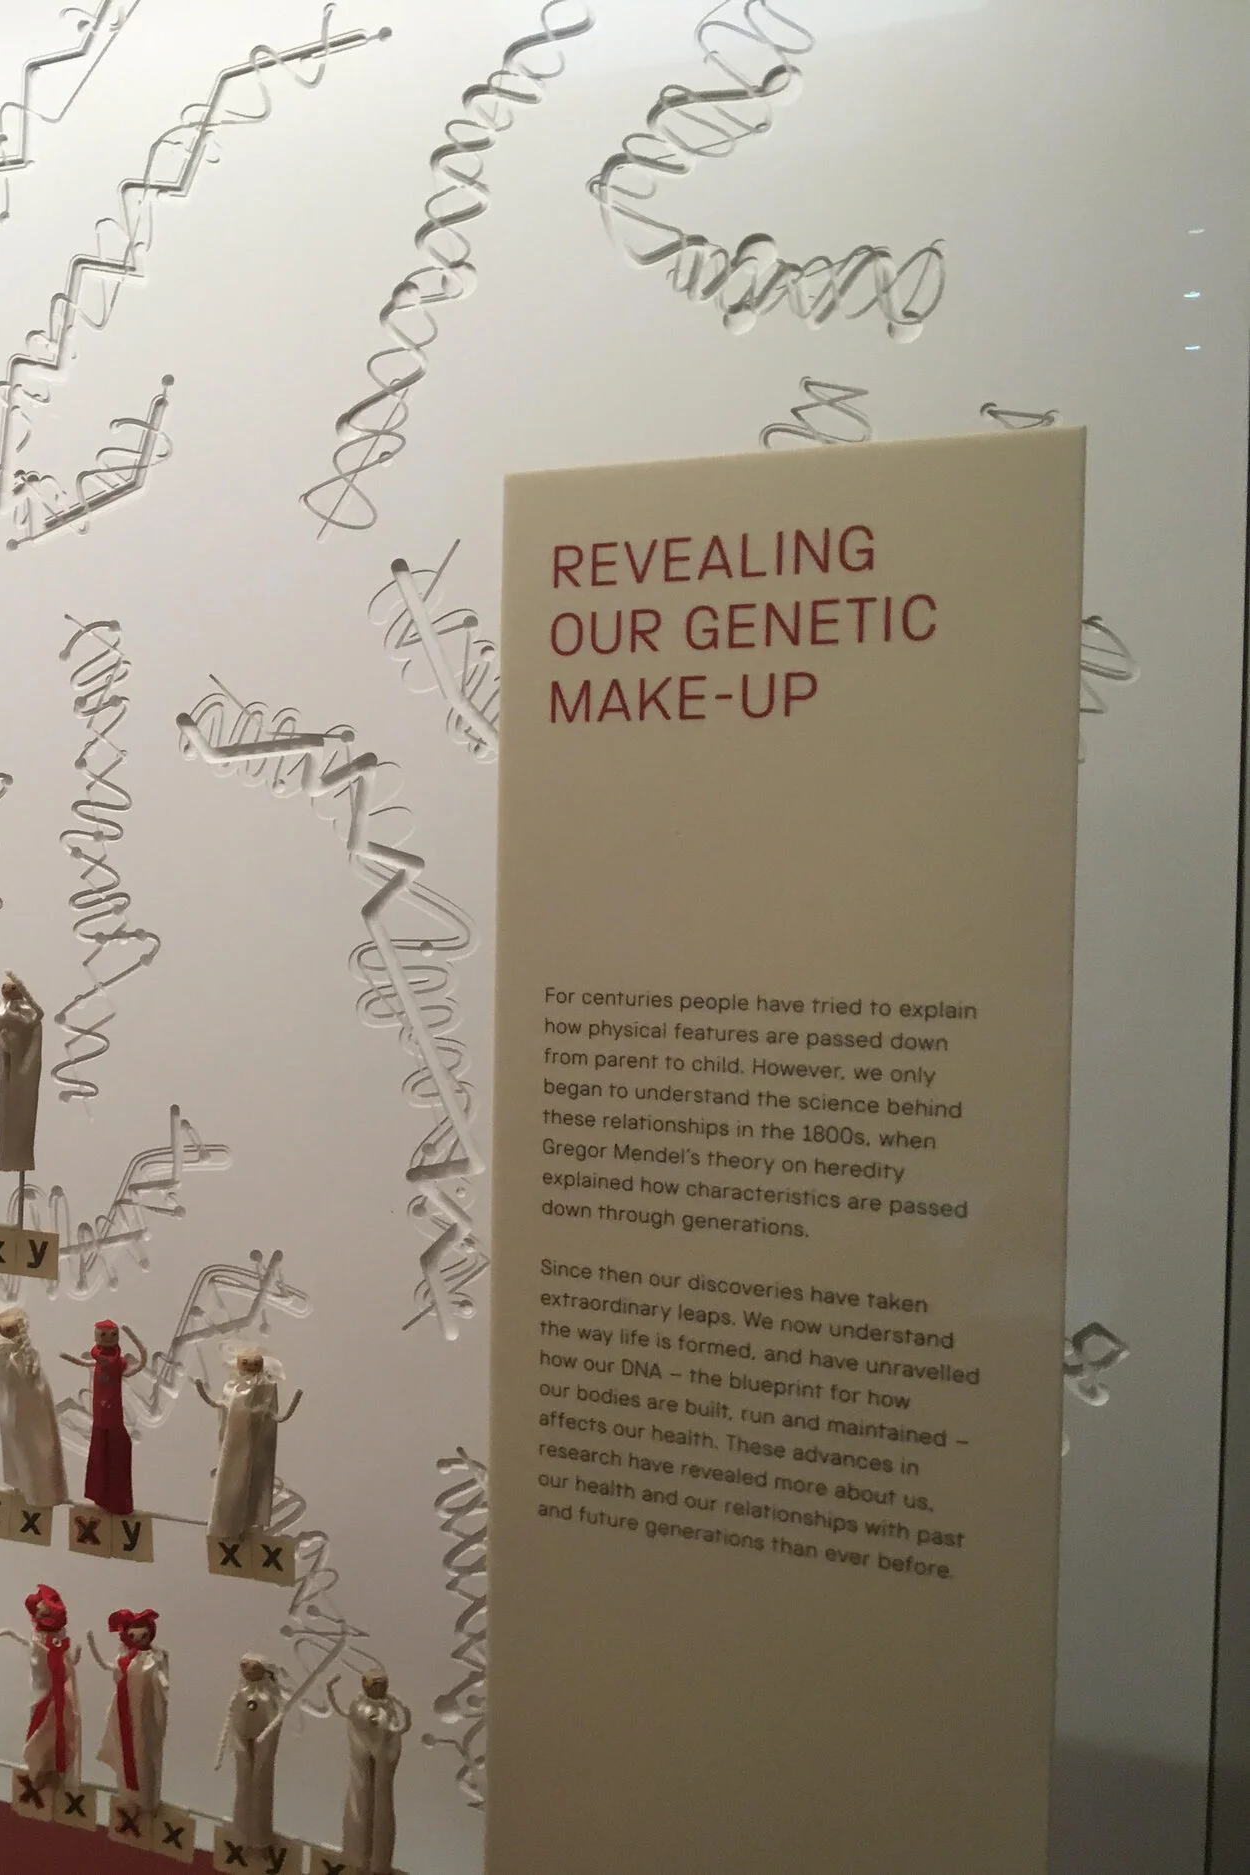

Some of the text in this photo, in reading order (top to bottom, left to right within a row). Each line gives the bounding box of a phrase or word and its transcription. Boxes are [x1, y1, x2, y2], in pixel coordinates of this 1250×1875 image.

[552, 524, 875, 589] REVEALING
[550, 593, 937, 657] OUR GENETIC
[549, 671, 818, 724] MAKE-UP
[544, 986, 978, 1023] For centuries people have tried to explain
[544, 1015, 949, 1052] how physical features are passed down
[543, 1046, 937, 1088] from parent to child. However, we only
[543, 1077, 963, 1120] began to understand the science behind
[541, 1108, 937, 1151] these relationships in the 1800s, when
[541, 1137, 608, 1163] Gregor
[706, 1150, 776, 1176] theory
[780, 1158, 808, 1174] on
[813, 1157, 906, 1185] heredity
[541, 1170, 969, 1220] explained how characteristics are passed
[541, 1198, 810, 1239] down through generations.
[539, 1257, 929, 1314] Since then our discoveries have taken
[539, 1292, 956, 1351] extraordinary leaps. We now understand
[539, 1318, 981, 1386] the way life is formed, and have unravelled
[539, 1347, 579, 1370] how
[582, 1357, 616, 1374] our
[620, 1357, 663, 1380] DNA
[688, 1367, 723, 1388] the
[728, 1370, 824, 1400] blueprint
[829, 1383, 862, 1404] for
[867, 1387, 912, 1411] how
[538, 1382, 571, 1399] our
[576, 1384, 642, 1409] bodies
[646, 1396, 680, 1414] are
[684, 1397, 733, 1422] built,
[740, 1408, 776, 1425] run
[781, 1413, 821, 1432] and
[826, 1418, 948, 1448] maintained
[538, 1410, 920, 1476] affects our health. These advances in
[538, 1443, 935, 1513] research have revealed more about us,
[537, 1473, 966, 1549] our health and our relationships with past
[537, 1503, 573, 1521] and
[578, 1505, 640, 1532] future
[644, 1519, 766, 1552] generations
[770, 1535, 819, 1559] than
[824, 1547, 871, 1567] ever
